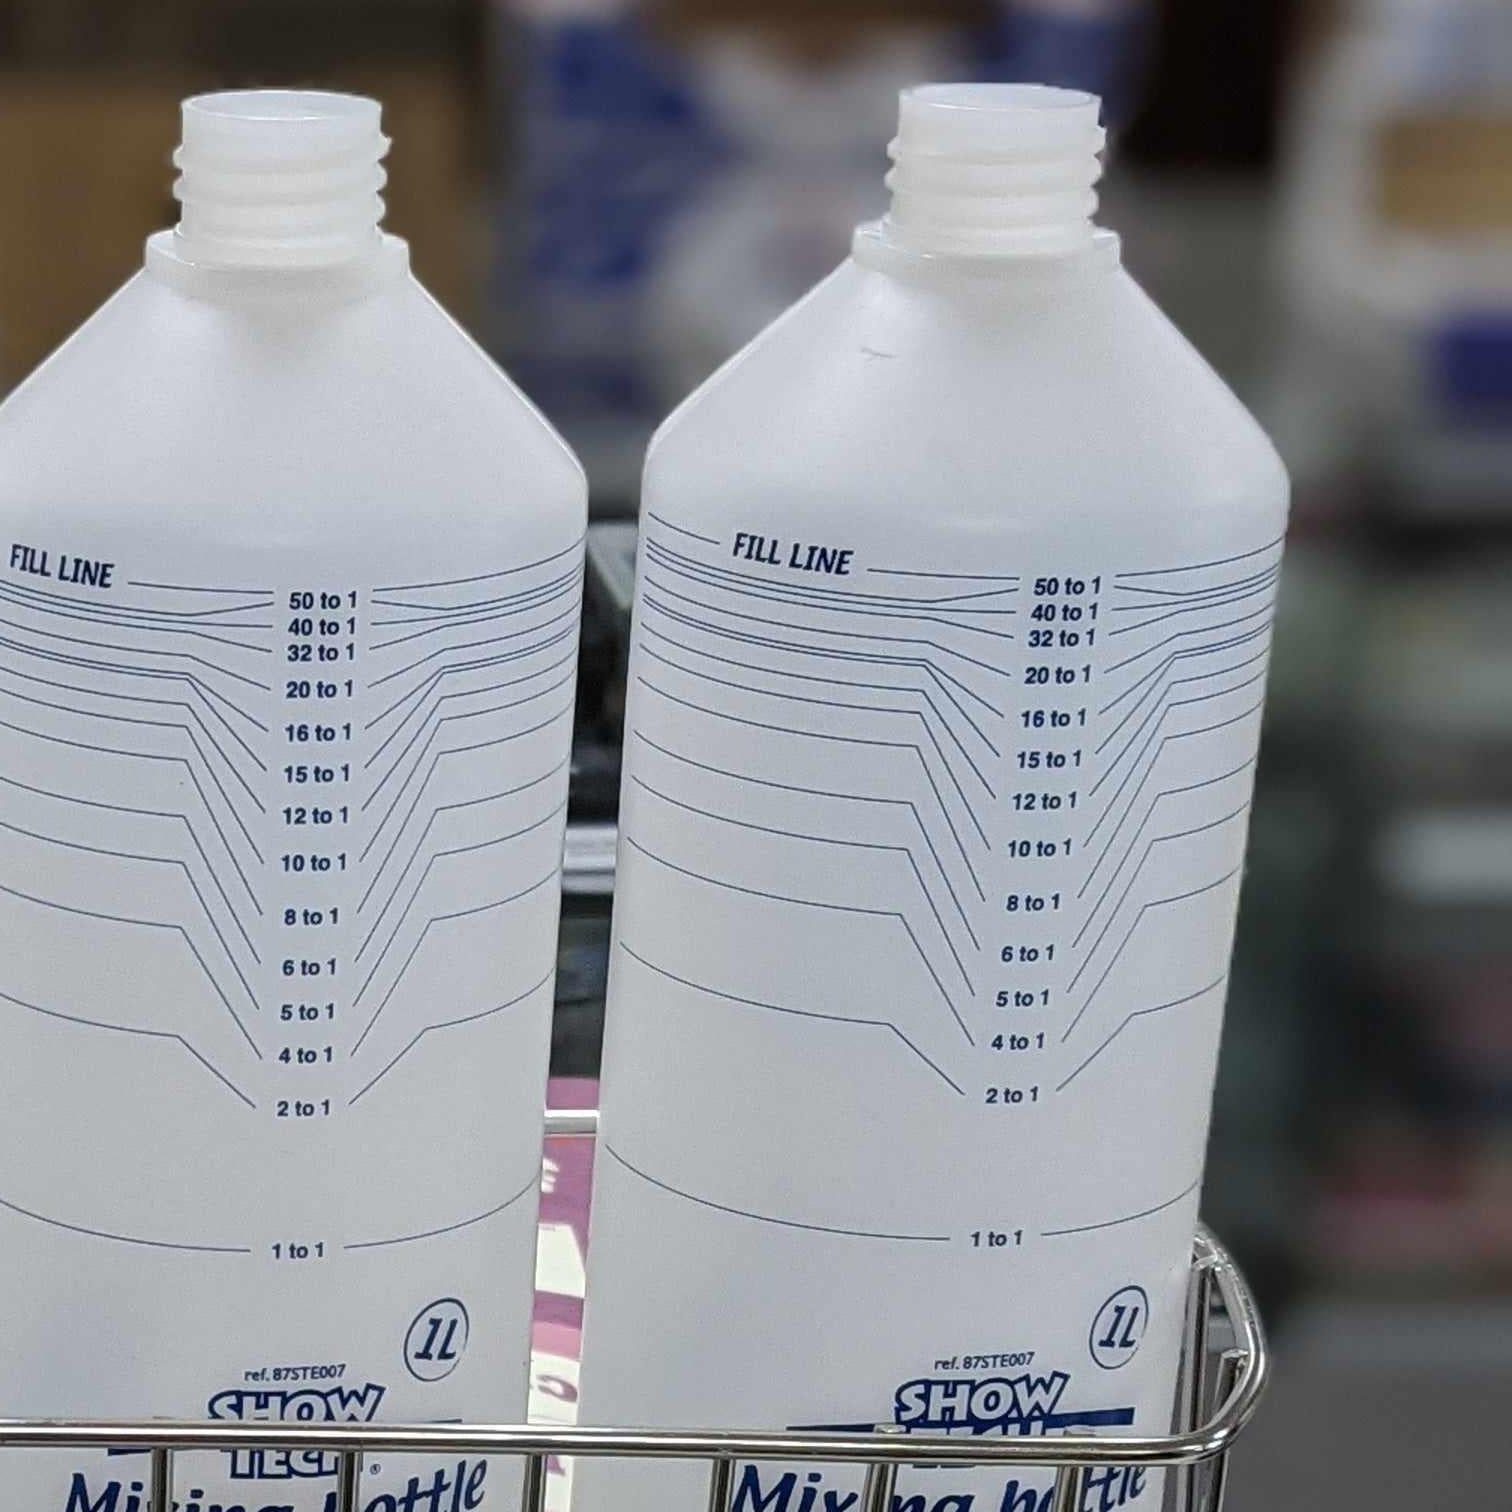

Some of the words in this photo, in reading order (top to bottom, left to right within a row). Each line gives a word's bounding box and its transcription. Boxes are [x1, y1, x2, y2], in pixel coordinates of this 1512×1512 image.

[732, 532, 781, 566] FILL
[789, 543, 854, 576] LINE
[9, 544, 51, 577] FILL
[58, 554, 114, 589] LINE
[1033, 576, 1060, 597] 50
[1063, 576, 1086, 596] to
[1091, 575, 1101, 595] 1
[285, 680, 312, 700] 20
[315, 680, 338, 699] to
[343, 678, 353, 698] 1
[1020, 709, 1046, 729] 16
[1049, 709, 1071, 728] to
[1077, 707, 1087, 727] 1
[281, 806, 307, 826] 12
[311, 806, 333, 825] to
[339, 805, 349, 824] 1
[1005, 894, 1020, 913] 8
[1024, 894, 1045, 913] to
[1050, 892, 1061, 911] 1
[283, 907, 297, 927] 8
[301, 908, 324, 927] to
[328, 906, 339, 925] 1
[995, 990, 1009, 1008] 5
[1013, 990, 1035, 1008] to
[1040, 988, 1050, 1006] 1
[271, 1242, 282, 1260] 1
[287, 1242, 309, 1260] to
[314, 1241, 324, 1259] 1
[1098, 1306, 1139, 1349] 1L
[413, 1317, 459, 1361] 1L
[244, 1368, 270, 1382] ref.
[273, 1363, 346, 1381] 87STE007
[934, 1356, 959, 1371] ref.
[963, 1352, 1035, 1369] 87STE007
[208, 1384, 385, 1422] SHOW
[894, 1371, 1070, 1424] SHOW
